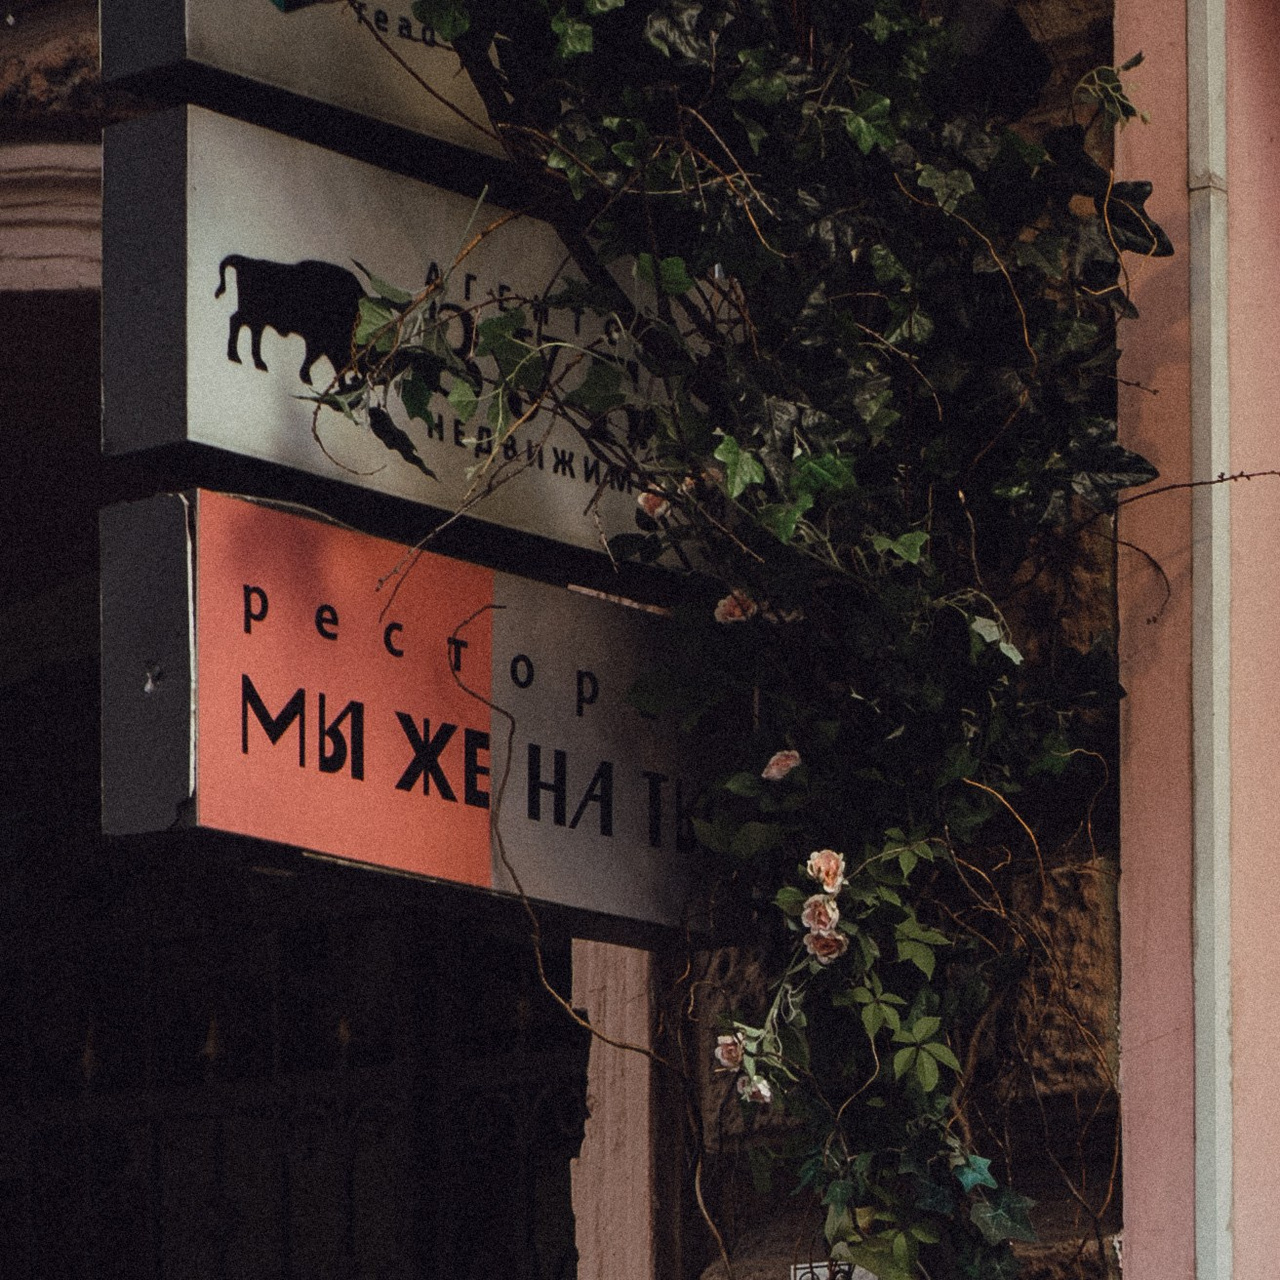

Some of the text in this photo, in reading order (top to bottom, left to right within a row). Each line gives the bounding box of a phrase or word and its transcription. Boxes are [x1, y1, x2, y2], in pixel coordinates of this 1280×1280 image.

[243, 584, 600, 717] рестор
[395, 711, 490, 809] ЖЕ
[528, 743, 614, 837] НА
